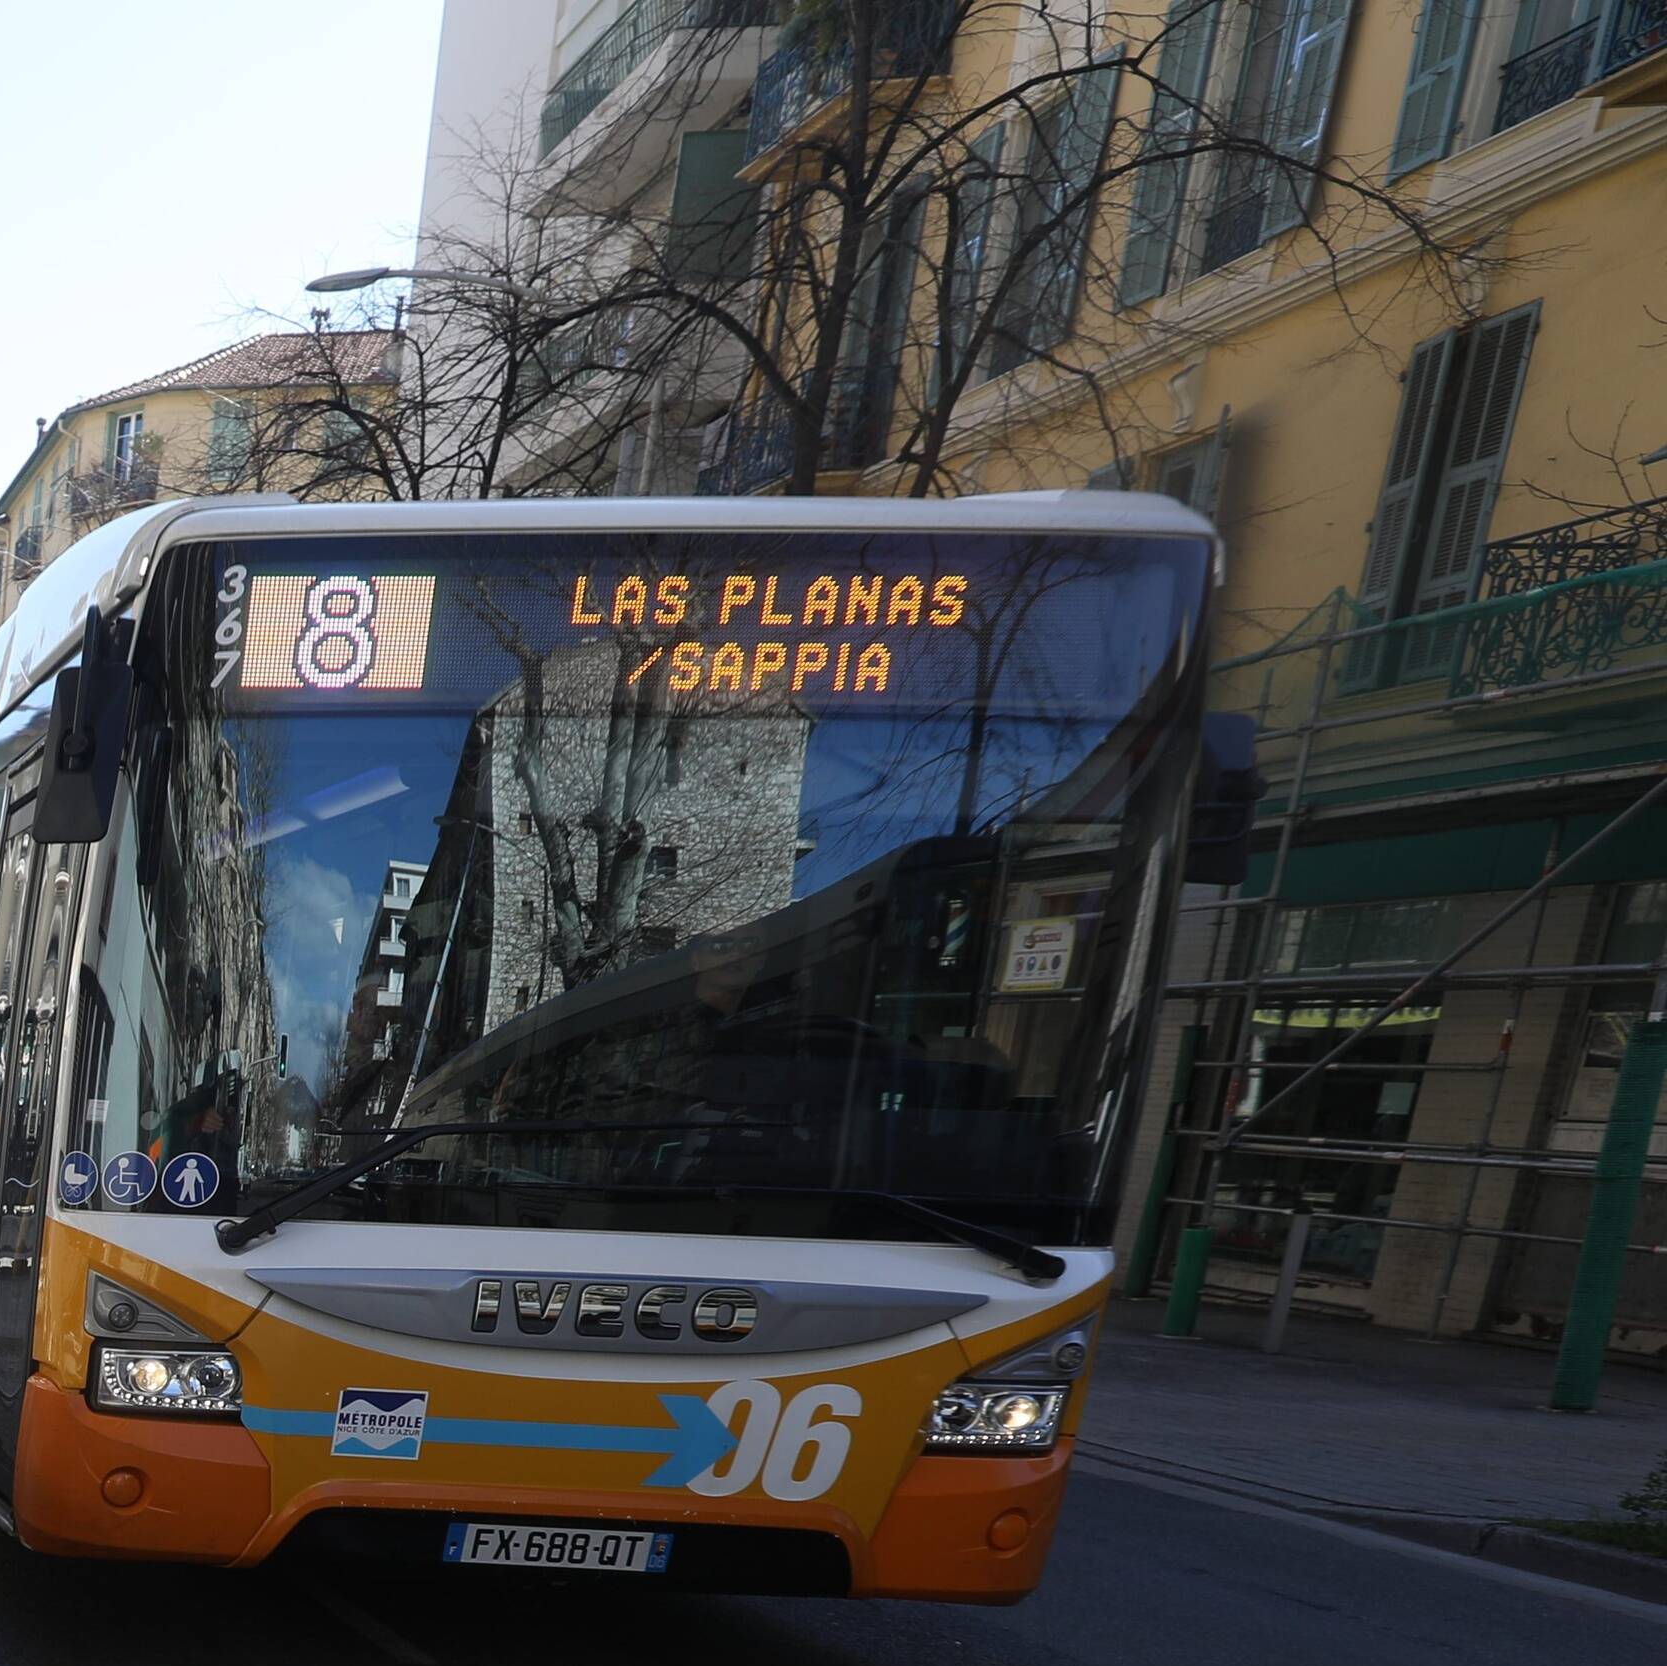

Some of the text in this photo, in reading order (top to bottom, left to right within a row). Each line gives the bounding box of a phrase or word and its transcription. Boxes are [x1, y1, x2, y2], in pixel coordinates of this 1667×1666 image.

[571, 575, 968, 625] LAS PLANAS
[296, 575, 374, 688] 8
[628, 641, 892, 692] /SAPPIA
[470, 1280, 759, 1343] IVECO
[338, 1411, 423, 1428] MÉTROPOLE
[362, 1426, 385, 1435] CÔTE
[389, 1428, 421, 1436] D'AZUR
[686, 1379, 863, 1502] 06
[470, 1528, 645, 1567] FX-688-QT
